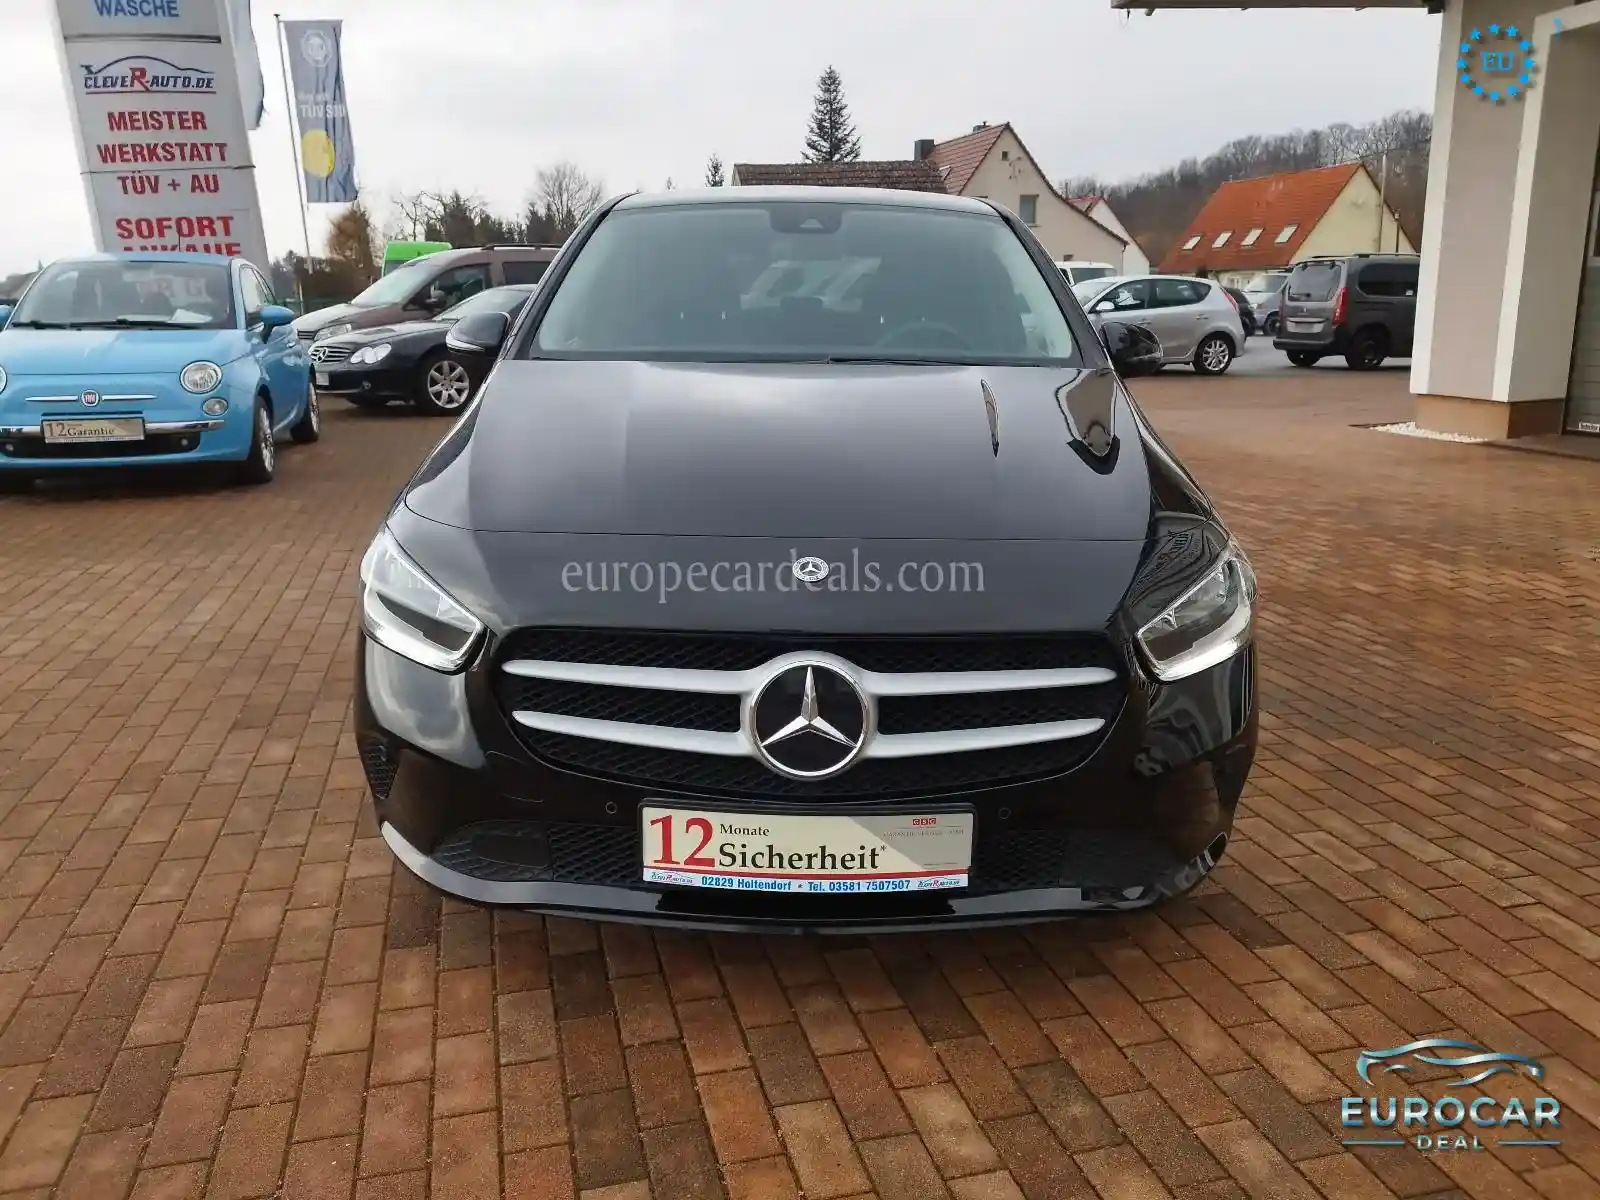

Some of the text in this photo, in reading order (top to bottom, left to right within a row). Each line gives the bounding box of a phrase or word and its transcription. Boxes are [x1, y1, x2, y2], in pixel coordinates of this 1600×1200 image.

[84, 67, 214, 92] CLEVER-AUTO.DE
[107, 111, 208, 131] MEISTER
[97, 142, 228, 164] WERKSTATT
[117, 170, 160, 195] TÜV
[191, 174, 220, 193] AU
[115, 216, 234, 239] SOFORT
[67, 427, 115, 437] Garantie
[650, 814, 716, 868] 12
[719, 823, 770, 837] Monate
[701, 875, 734, 888] 02829
[737, 879, 793, 892] Holtendorf
[807, 881, 826, 892] Tel.
[828, 880, 861, 892] 03581
[866, 879, 911, 891] 7507507
